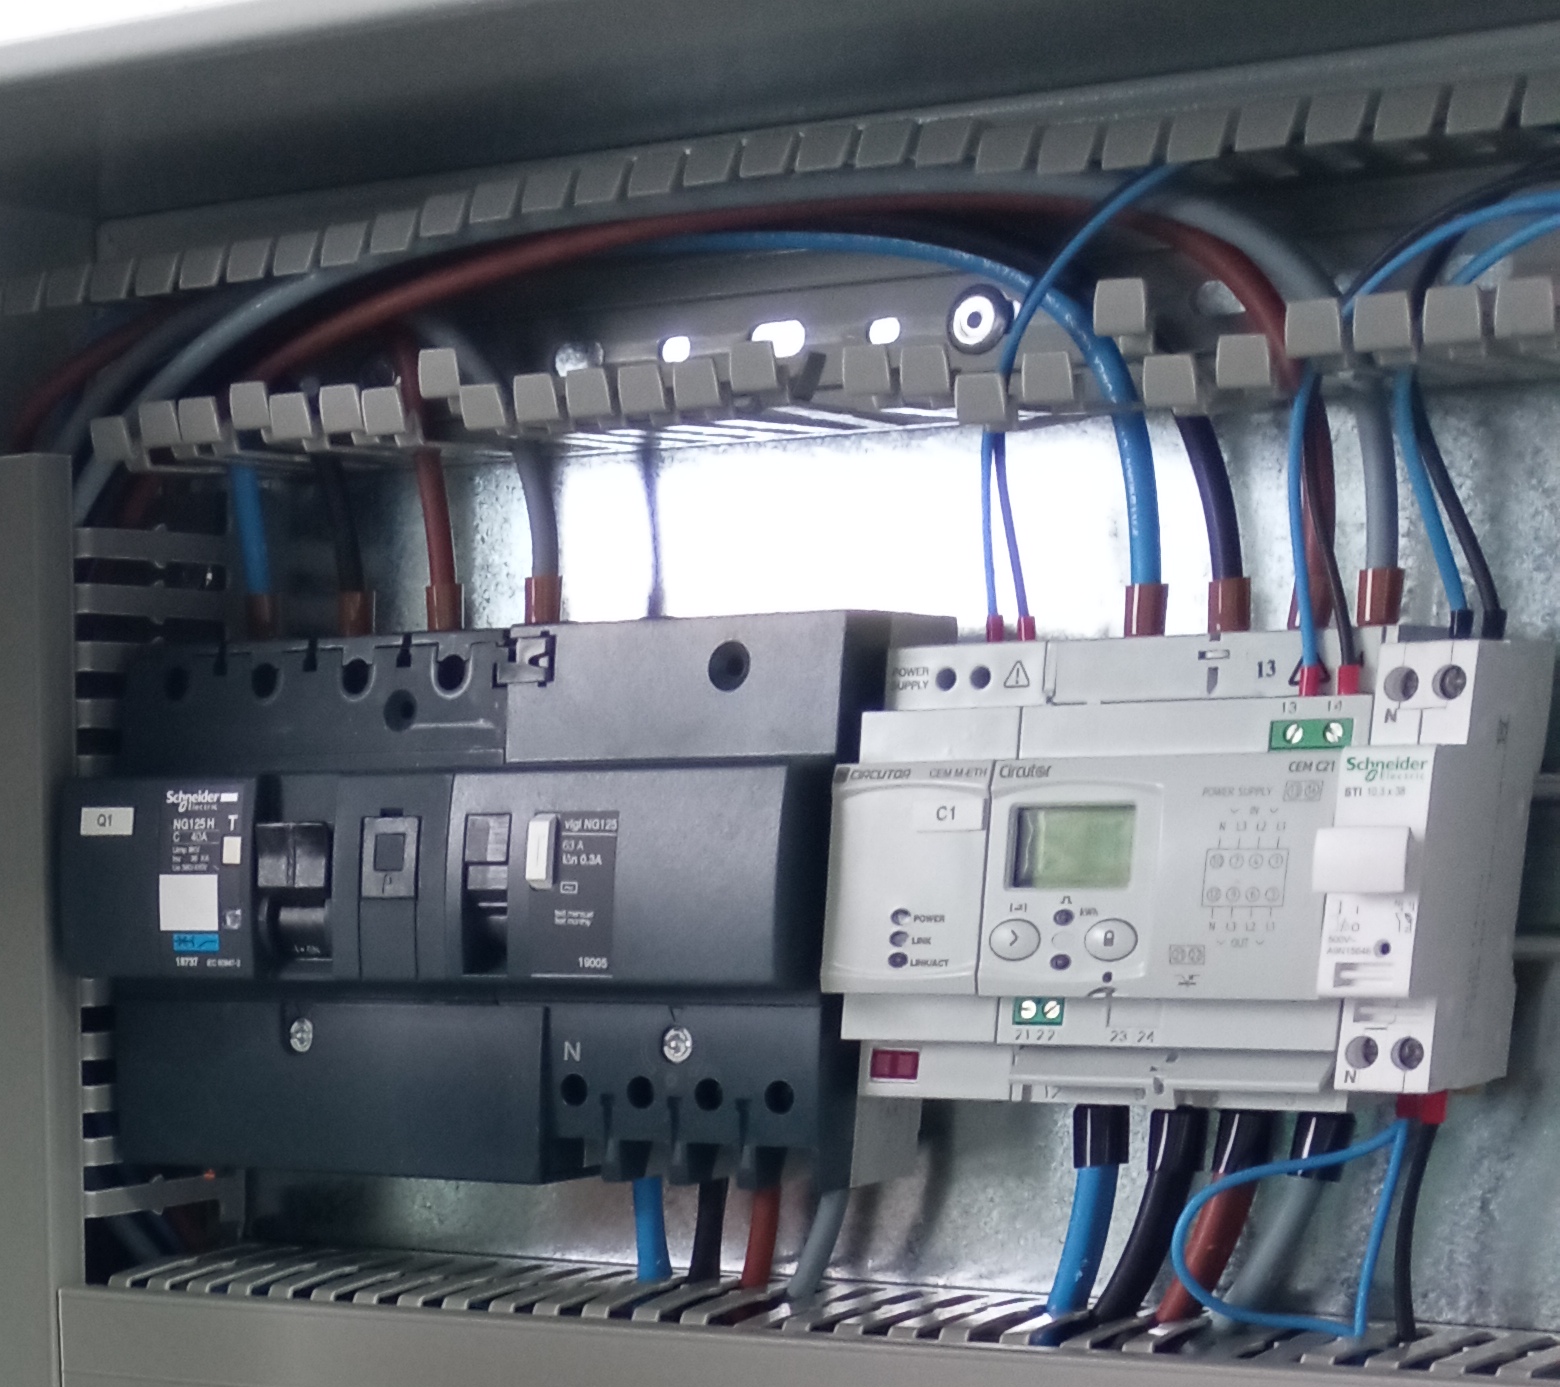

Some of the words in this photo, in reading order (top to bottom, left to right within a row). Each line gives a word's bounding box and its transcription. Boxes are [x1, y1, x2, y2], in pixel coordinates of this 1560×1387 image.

[1257, 660, 1277, 678] 13
[1385, 708, 1397, 723] N
[851, 769, 911, 779] CIRCUTOR
[1289, 761, 1313, 772] CEM
[1316, 761, 1336, 772] C21
[1346, 756, 1428, 781] Schneider
[166, 790, 220, 812] Schneider
[96, 813, 113, 828] Q1
[936, 806, 956, 821] C1
[228, 815, 238, 831] T
[584, 818, 617, 830] NG125
[913, 914, 944, 923] POWER
[578, 957, 608, 969] 19005
[564, 1041, 581, 1062] N
[1344, 1070, 1356, 1083] N
